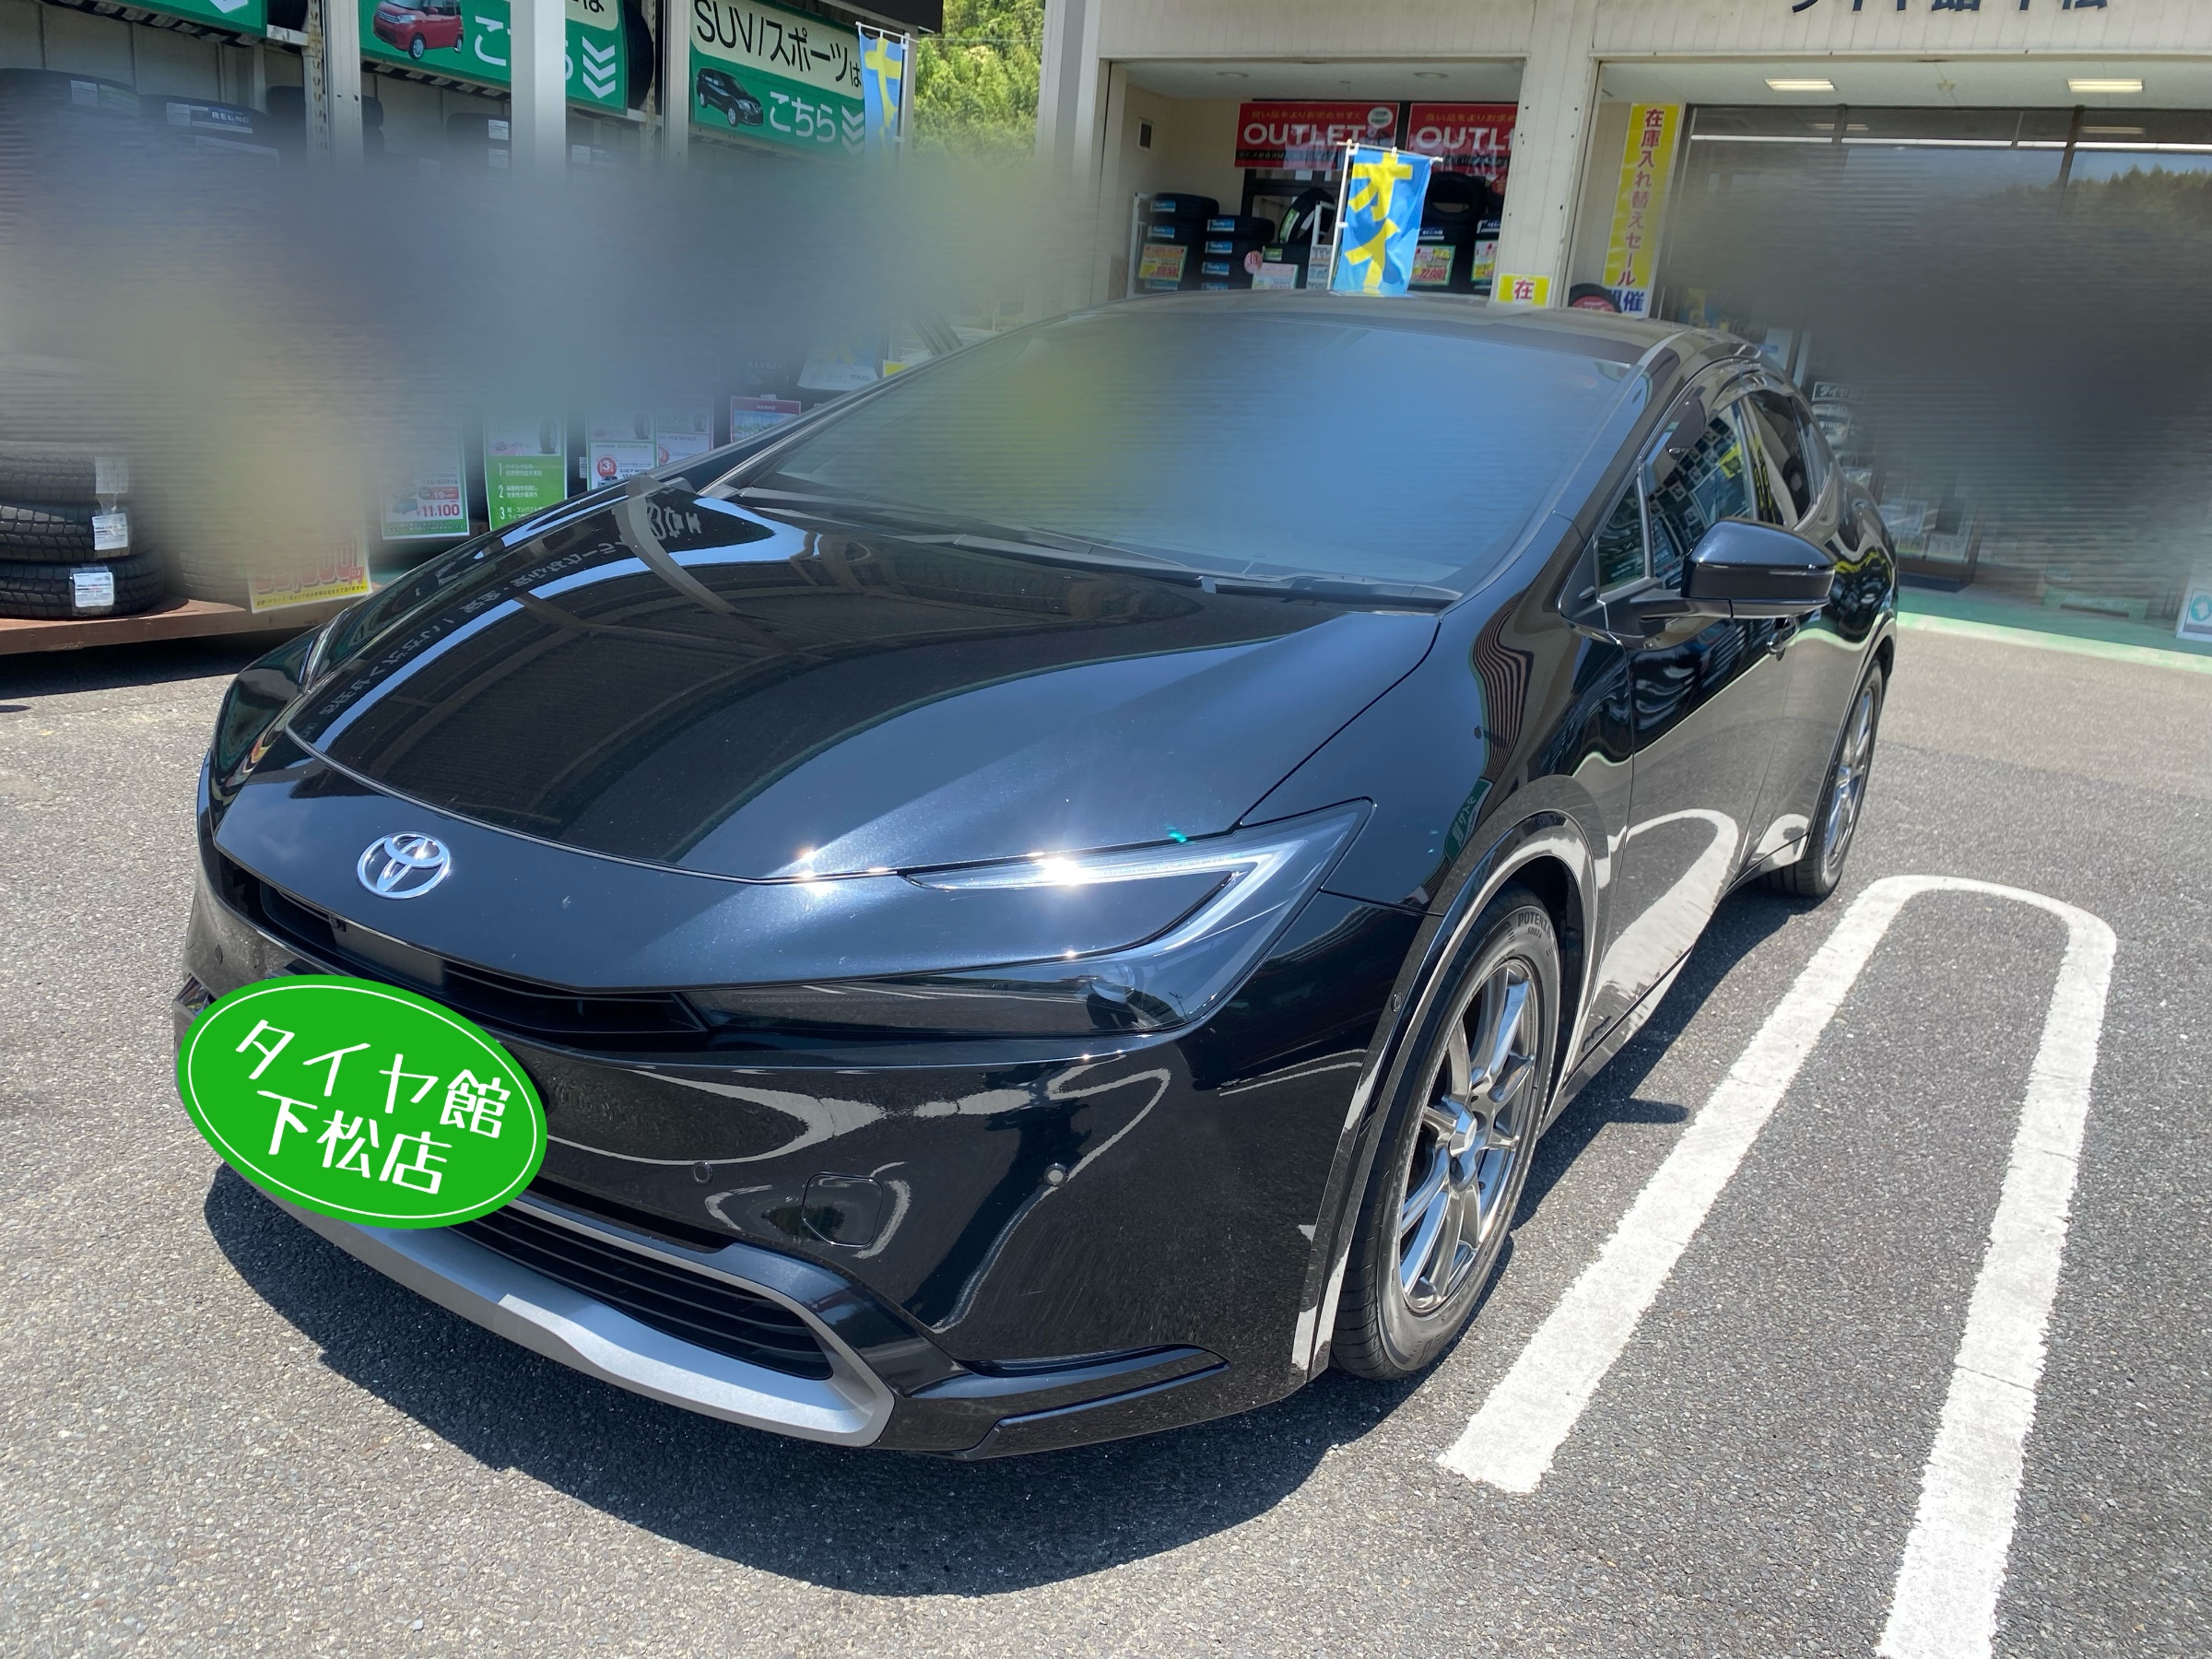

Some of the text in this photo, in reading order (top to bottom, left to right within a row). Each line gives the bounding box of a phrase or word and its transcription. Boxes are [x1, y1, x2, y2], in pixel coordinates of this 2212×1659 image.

[211, 111, 250, 124] REGNO
[770, 90, 837, 143] こちら
[1243, 123, 1367, 146] OUTLET
[1618, 109, 1665, 287] 在庫入れ替えセール
[1514, 279, 1535, 300] 在
[1517, 911, 1551, 939] POTENZA
